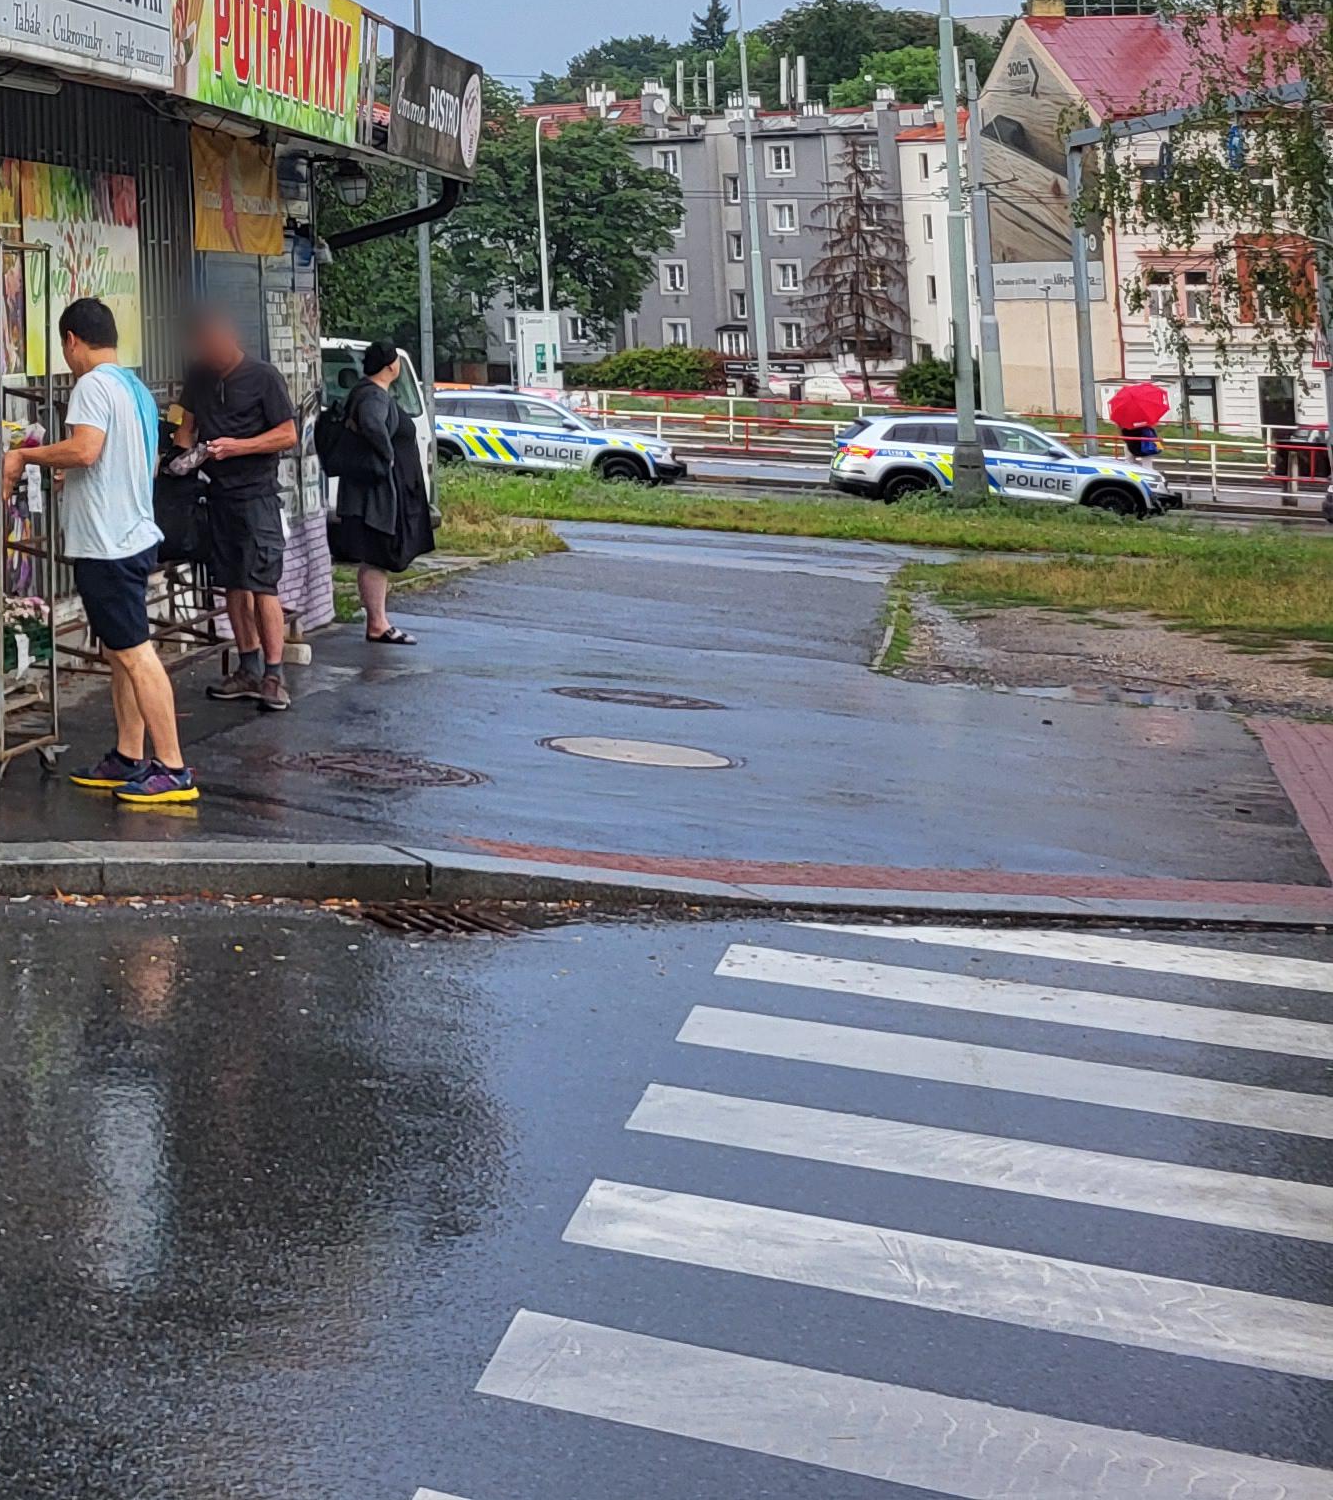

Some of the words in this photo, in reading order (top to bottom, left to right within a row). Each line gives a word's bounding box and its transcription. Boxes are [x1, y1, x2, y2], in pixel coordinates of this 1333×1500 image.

[14, 2, 41, 35] Tabák
[53, 14, 103, 57] Cukrovinky
[115, 32, 134, 64] Teplé
[429, 86, 460, 138] BISTRO
[524, 445, 583, 461] POLICIE
[1005, 474, 1073, 491] POLICIE
